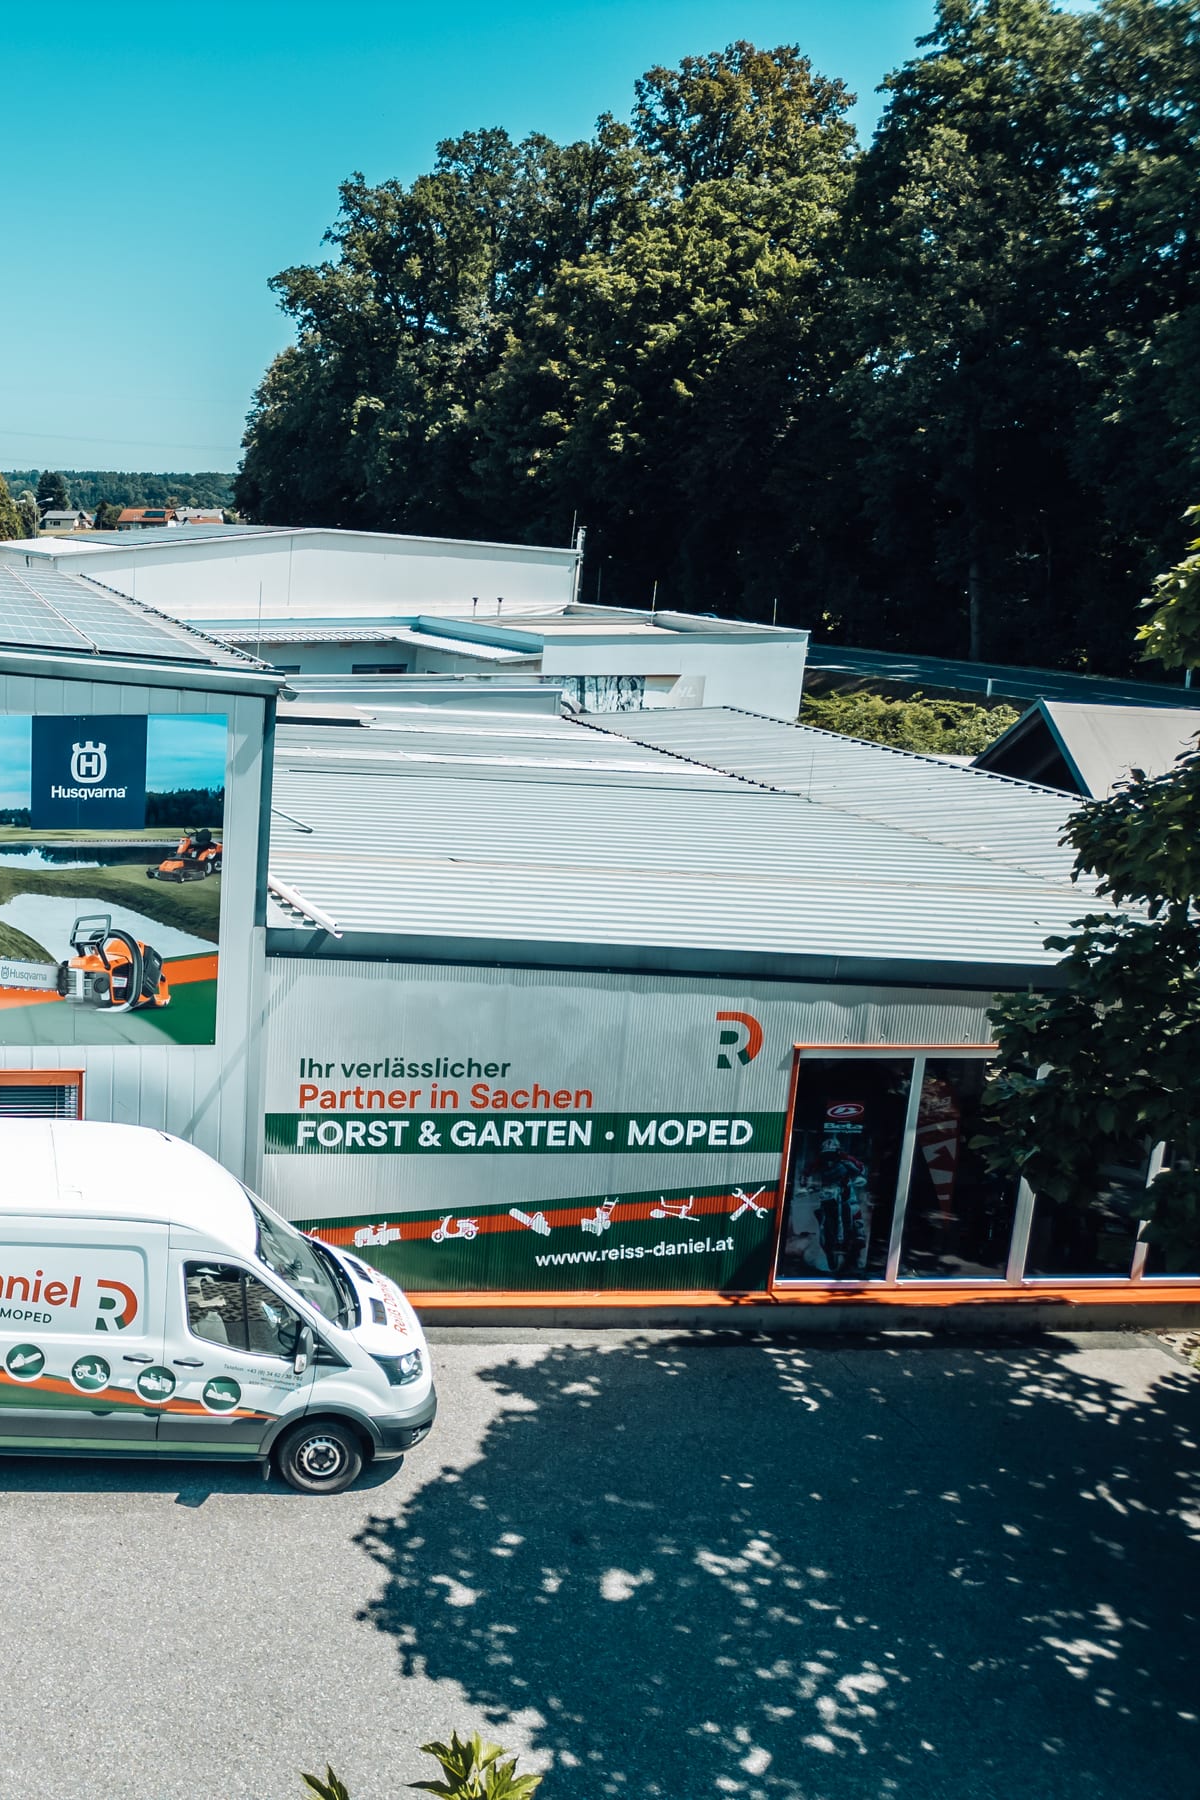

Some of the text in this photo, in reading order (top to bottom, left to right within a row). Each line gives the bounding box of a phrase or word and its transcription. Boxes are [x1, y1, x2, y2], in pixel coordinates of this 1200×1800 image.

[51, 785, 126, 801] Husqvarna
[9, 968, 48, 981] Husqvarna
[299, 1057, 511, 1079] Ihr verlässlicher
[298, 1083, 594, 1110] Partner in Sachen
[296, 1120, 410, 1148] FORST
[418, 1120, 442, 1148] &
[449, 1120, 593, 1148] GARTEN
[627, 1119, 755, 1147] MOPED
